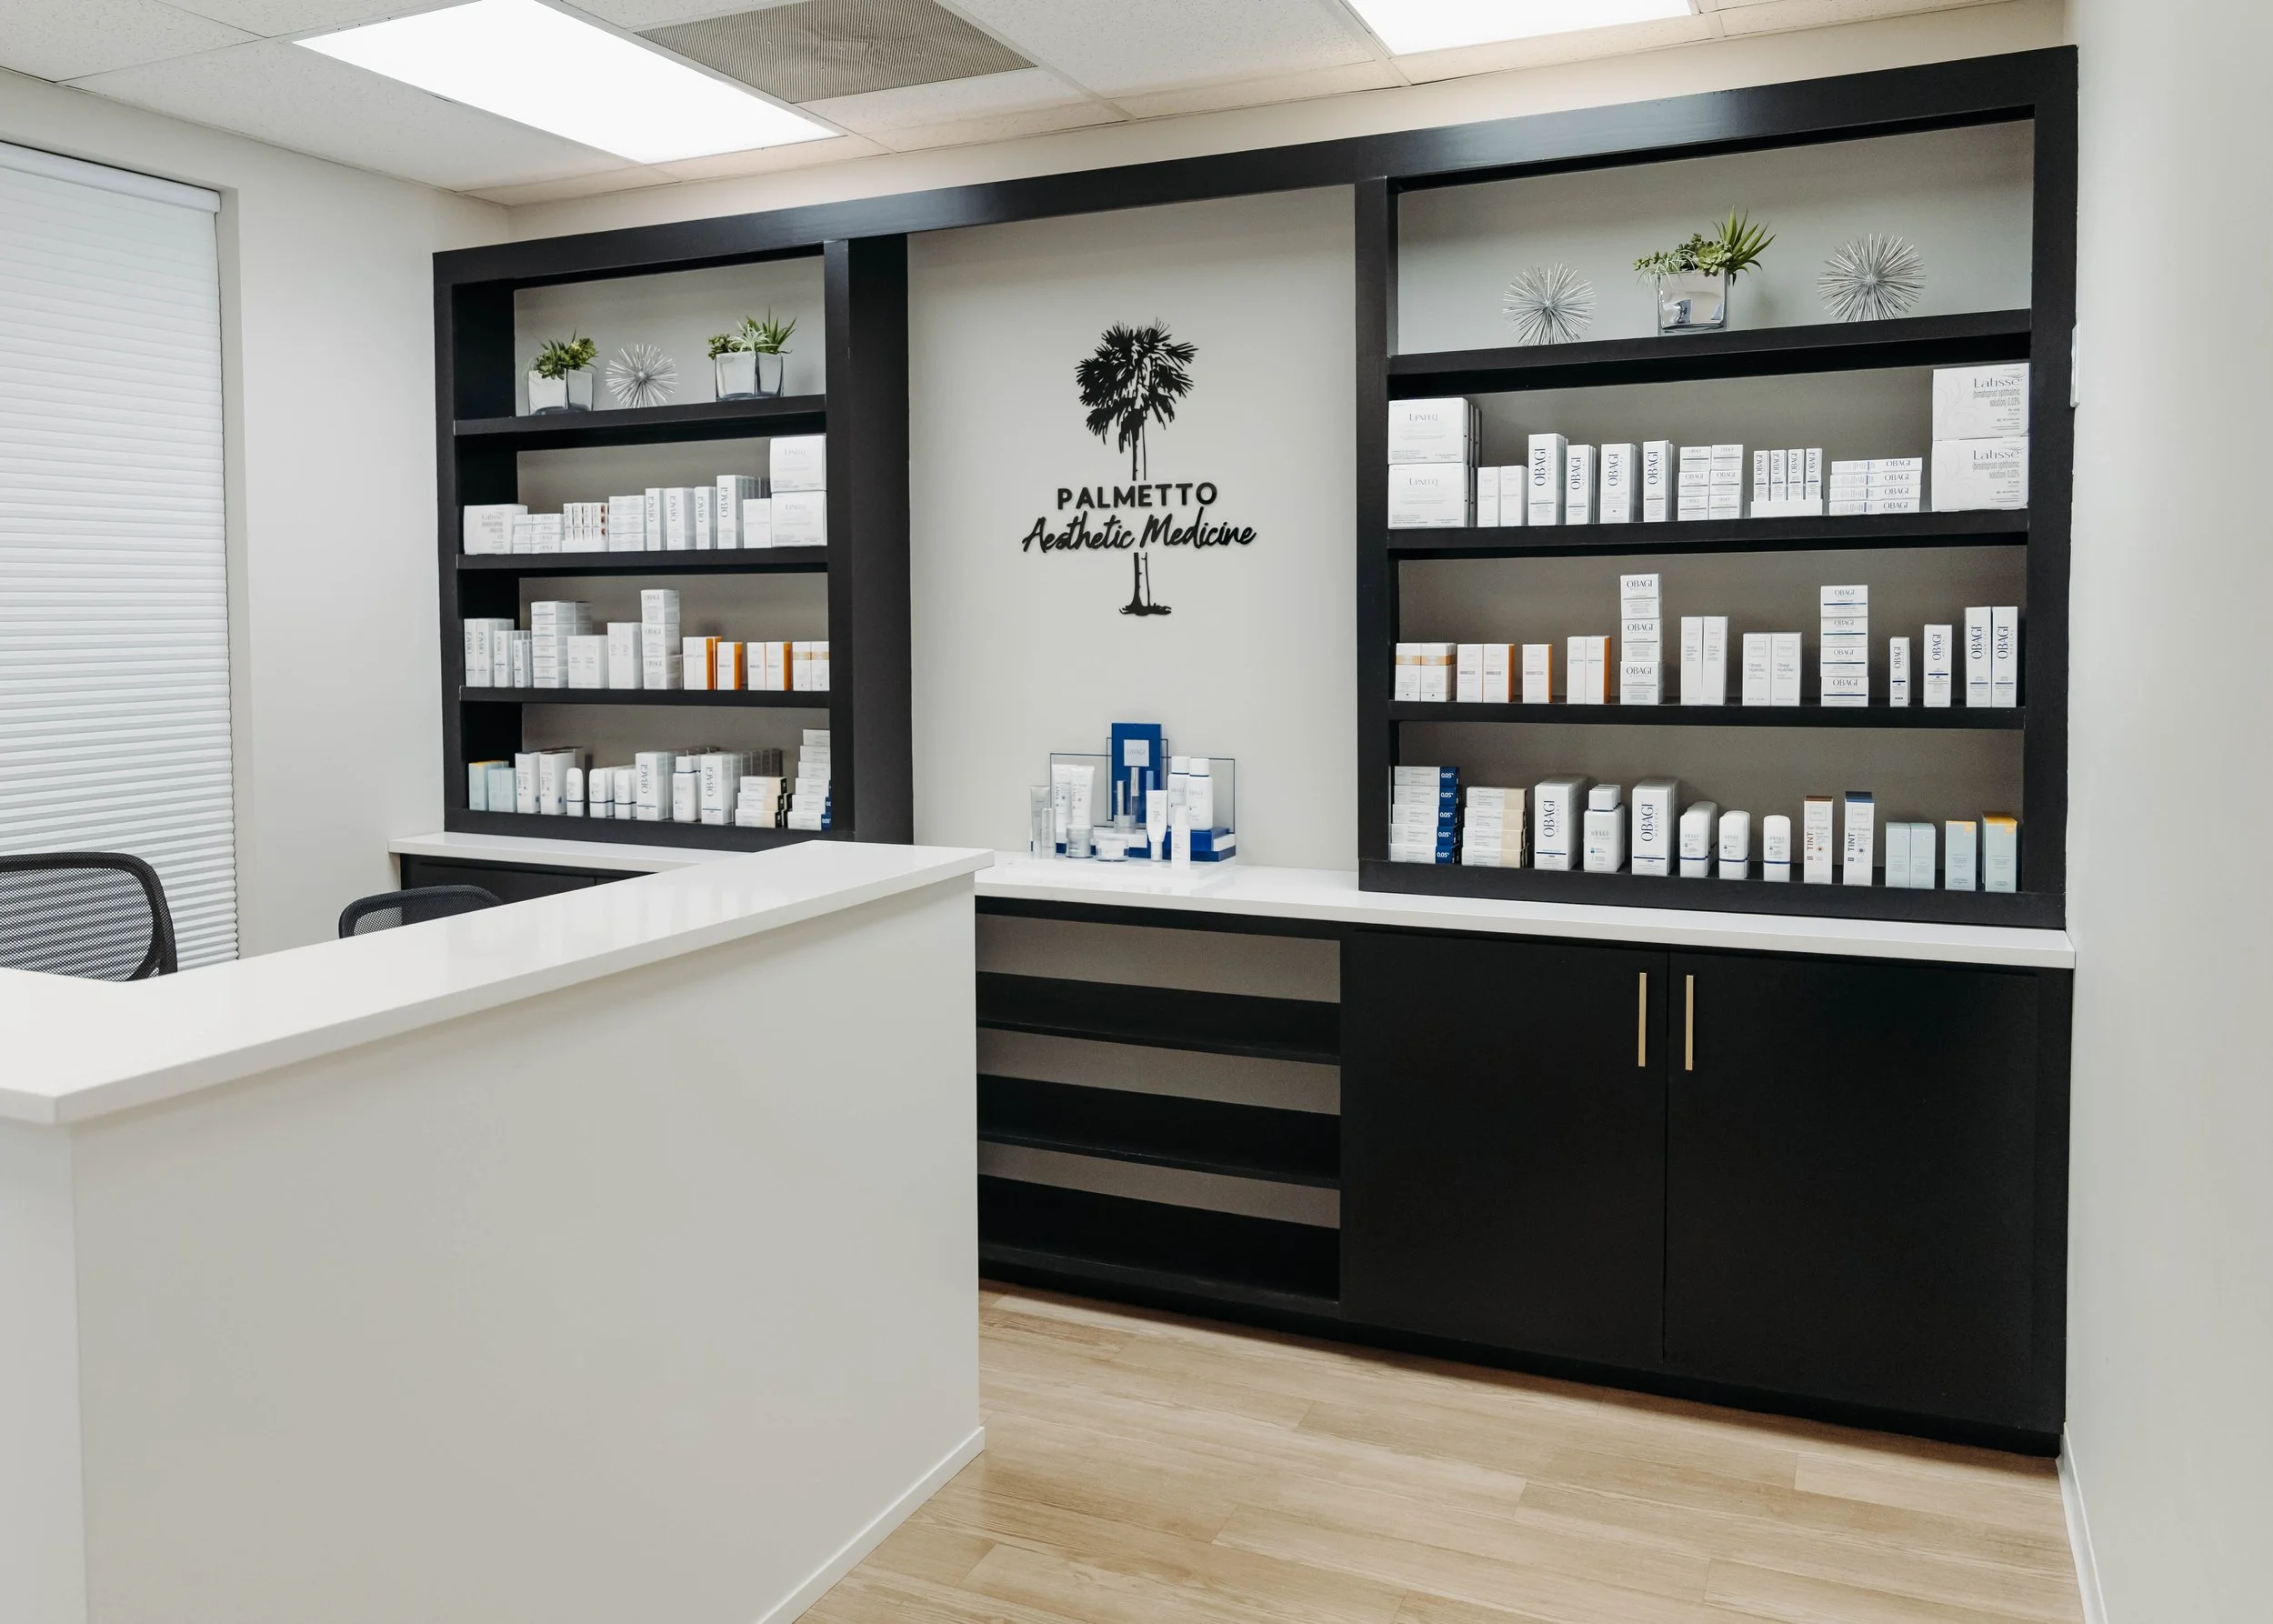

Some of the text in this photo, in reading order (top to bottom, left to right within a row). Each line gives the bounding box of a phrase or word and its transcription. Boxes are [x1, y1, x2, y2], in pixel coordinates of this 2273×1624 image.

[1974, 376, 2020, 388] Latisse
[1533, 447, 1547, 486] OBAGI
[1647, 450, 1658, 485] OBAGI
[1886, 459, 1911, 467] OBAGI
[1973, 449, 2020, 461] Latisse
[1570, 456, 1581, 490] OBAGI
[1607, 453, 1618, 486] OBAGI
[1057, 482, 1218, 510] PALMETTO
[1884, 487, 1909, 496] OBAGI
[1022, 506, 1257, 553] Aesthetic Medicine
[1627, 579, 1653, 588] OBAGI
[1627, 623, 1653, 632] OBAGI
[1932, 634, 1941, 661] OBAGI
[1971, 626, 1982, 659] OBAGI
[1997, 625, 2008, 659] OBAGI
[1626, 667, 1652, 675] OBAGI
[1832, 678, 1858, 687] OBAGI
[1543, 800, 1555, 837] OBAGI
[1640, 804, 1654, 842] OBAGI
[1847, 833, 1856, 851] TINT
